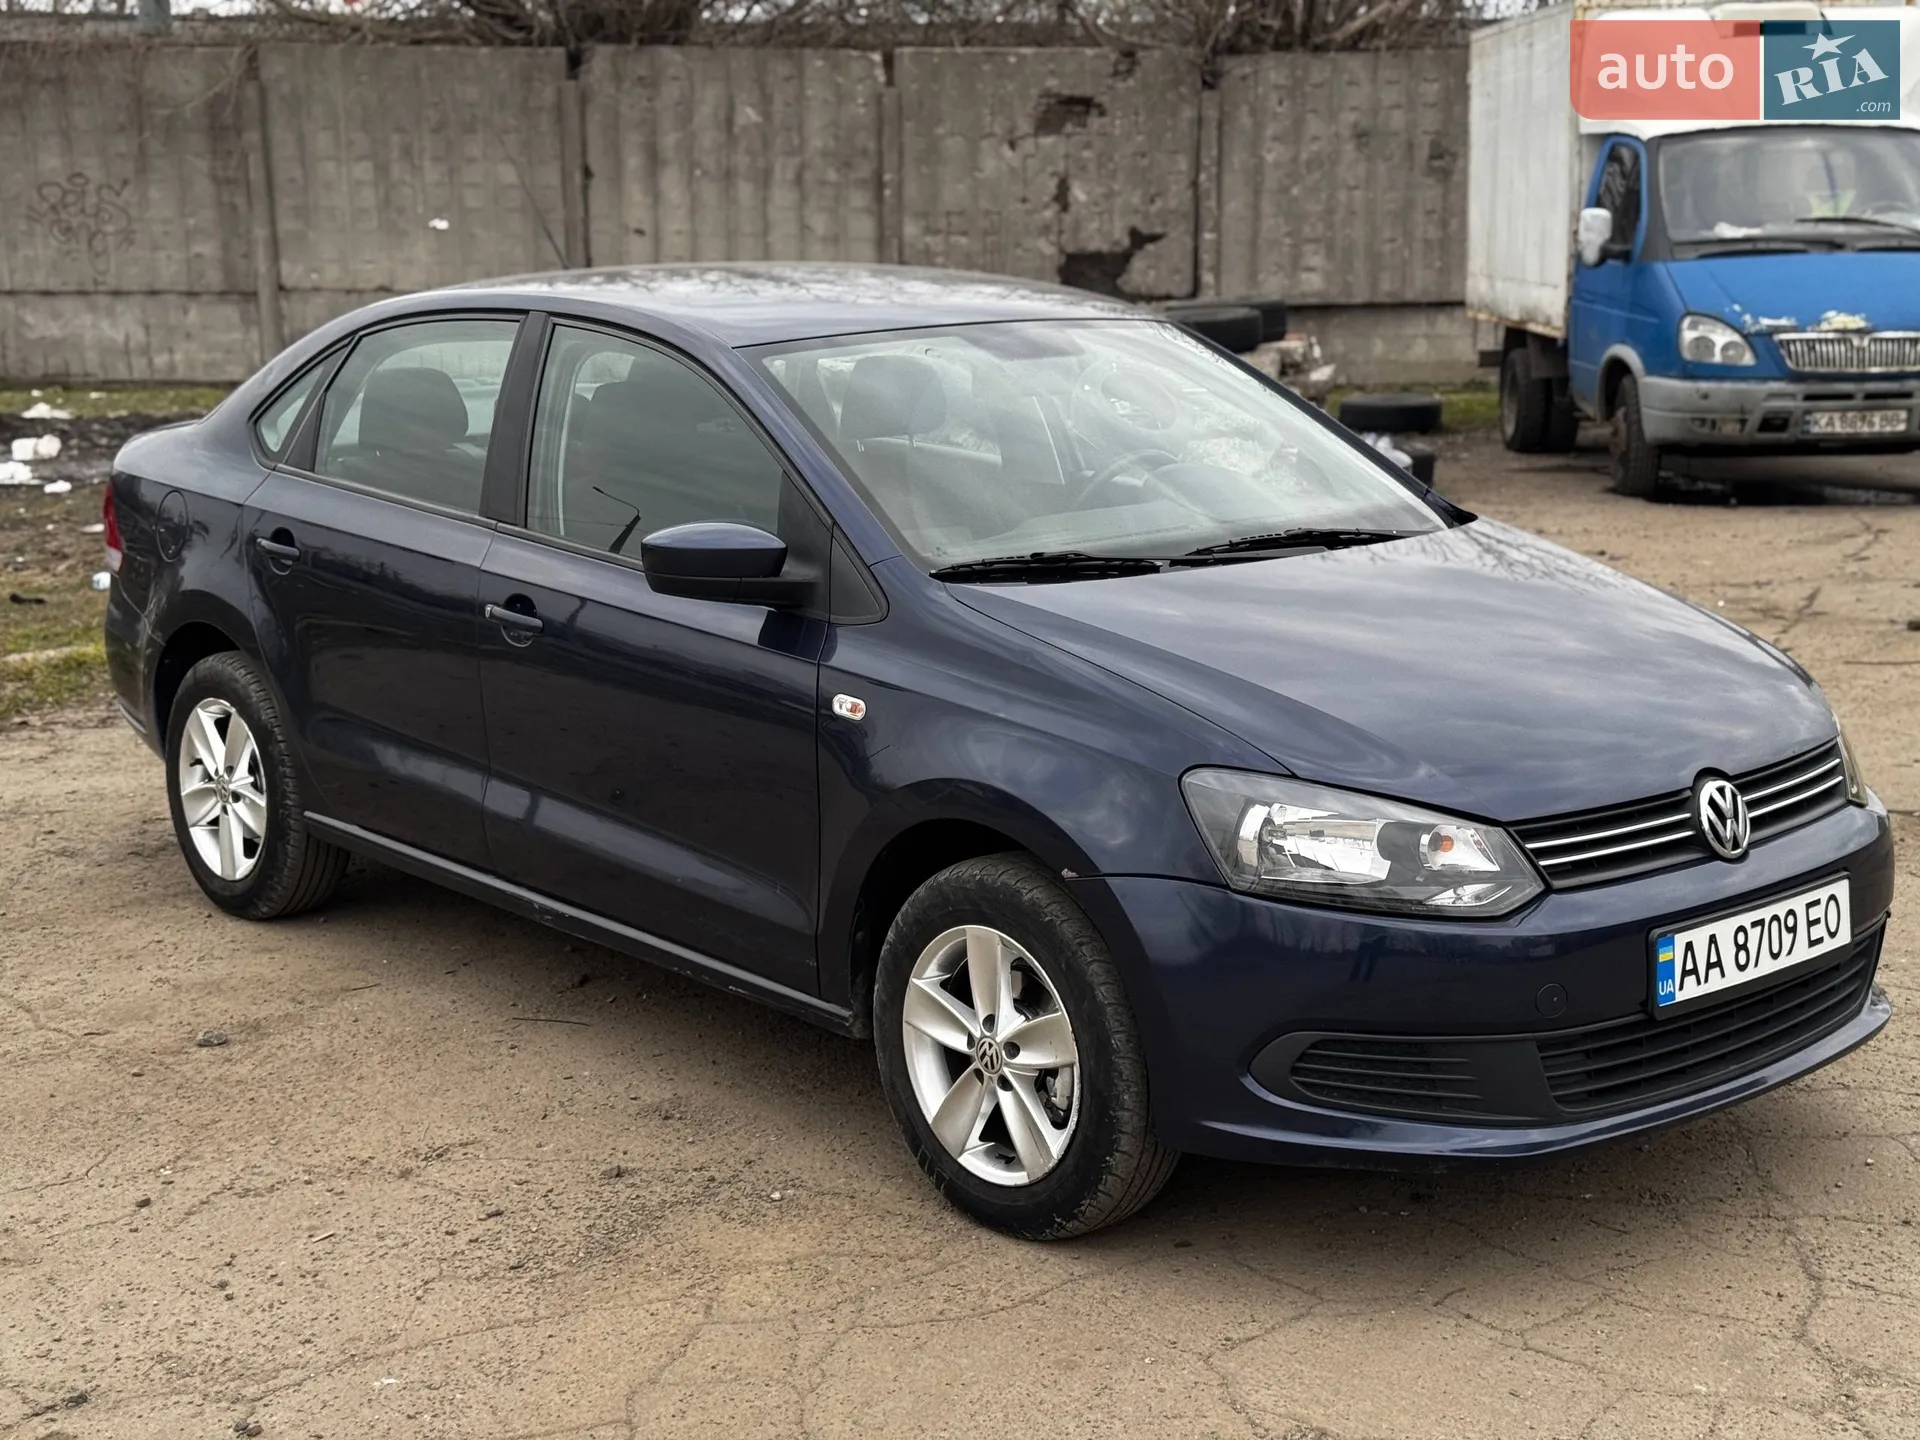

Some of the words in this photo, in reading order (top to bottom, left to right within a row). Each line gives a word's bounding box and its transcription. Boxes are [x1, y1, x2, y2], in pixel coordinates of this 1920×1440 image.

[1678, 933, 1726, 991] AA
[1733, 908, 1798, 972] 8709
[1805, 893, 1841, 948] EO
[1659, 979, 1674, 996] UA
